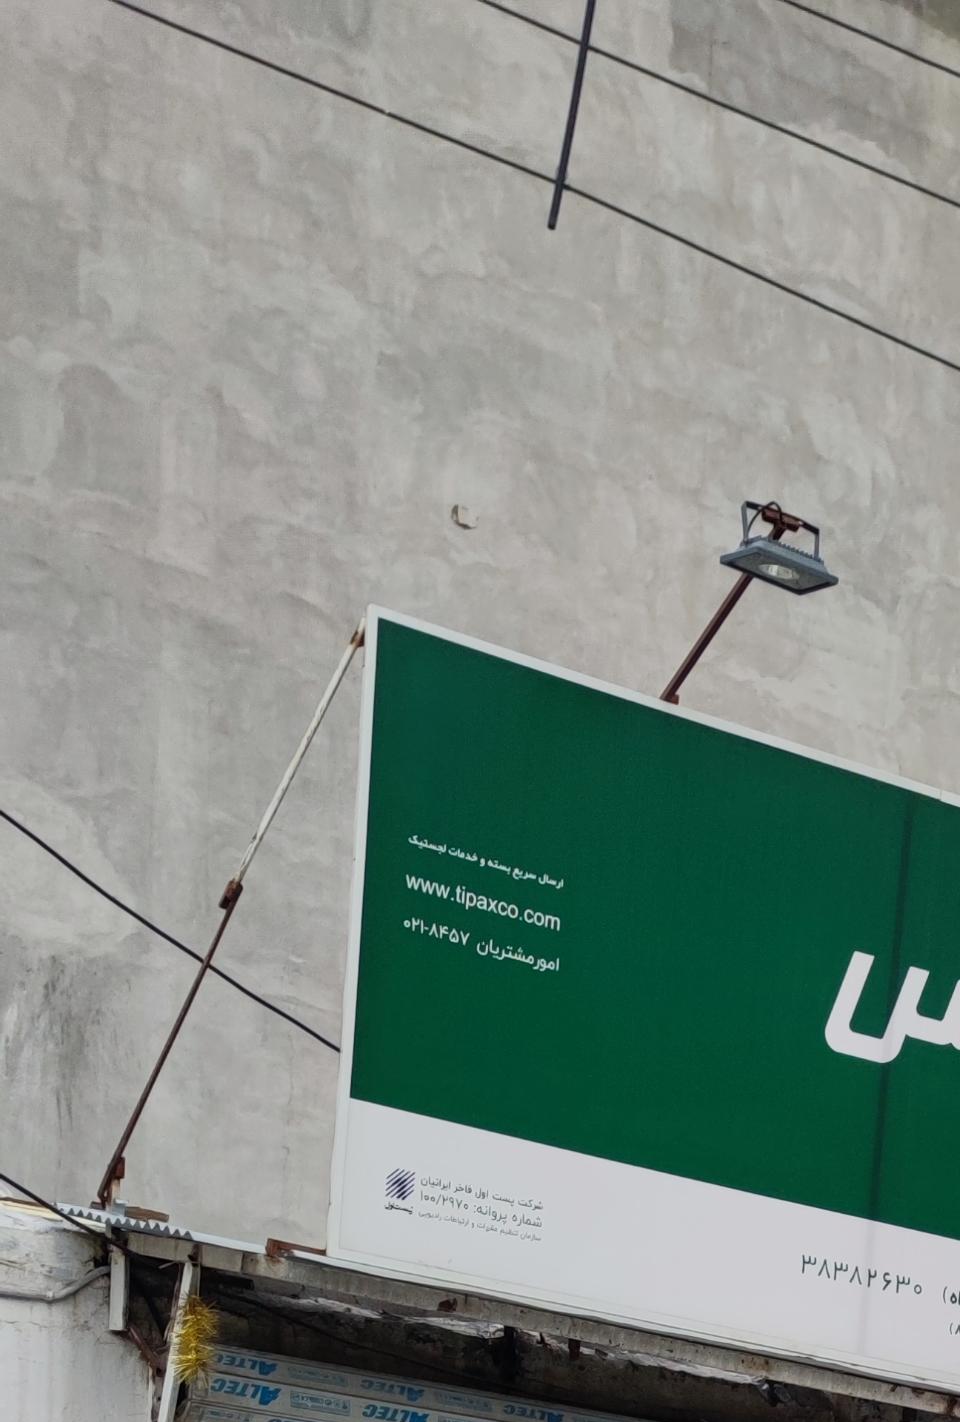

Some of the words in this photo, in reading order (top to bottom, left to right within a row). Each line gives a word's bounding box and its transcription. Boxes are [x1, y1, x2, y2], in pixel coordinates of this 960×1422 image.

[408, 835, 447, 855] لجستیک
[448, 847, 478, 862] خدمات
[487, 859, 511, 875] بسته
[512, 868, 537, 879] سریع
[538, 874, 564, 888] ارسال
[405, 874, 561, 931] www.tipaxco.com
[403, 917, 470, 946] ۰۲۱-۸۴۵۷
[474, 1203, 508, 1225] پروانه:
[512, 1212, 542, 1228] شماره
[800, 1253, 924, 1296] ۳۸۳۸۲۶۳۰
[210, 1377, 282, 1406] ALTEC
